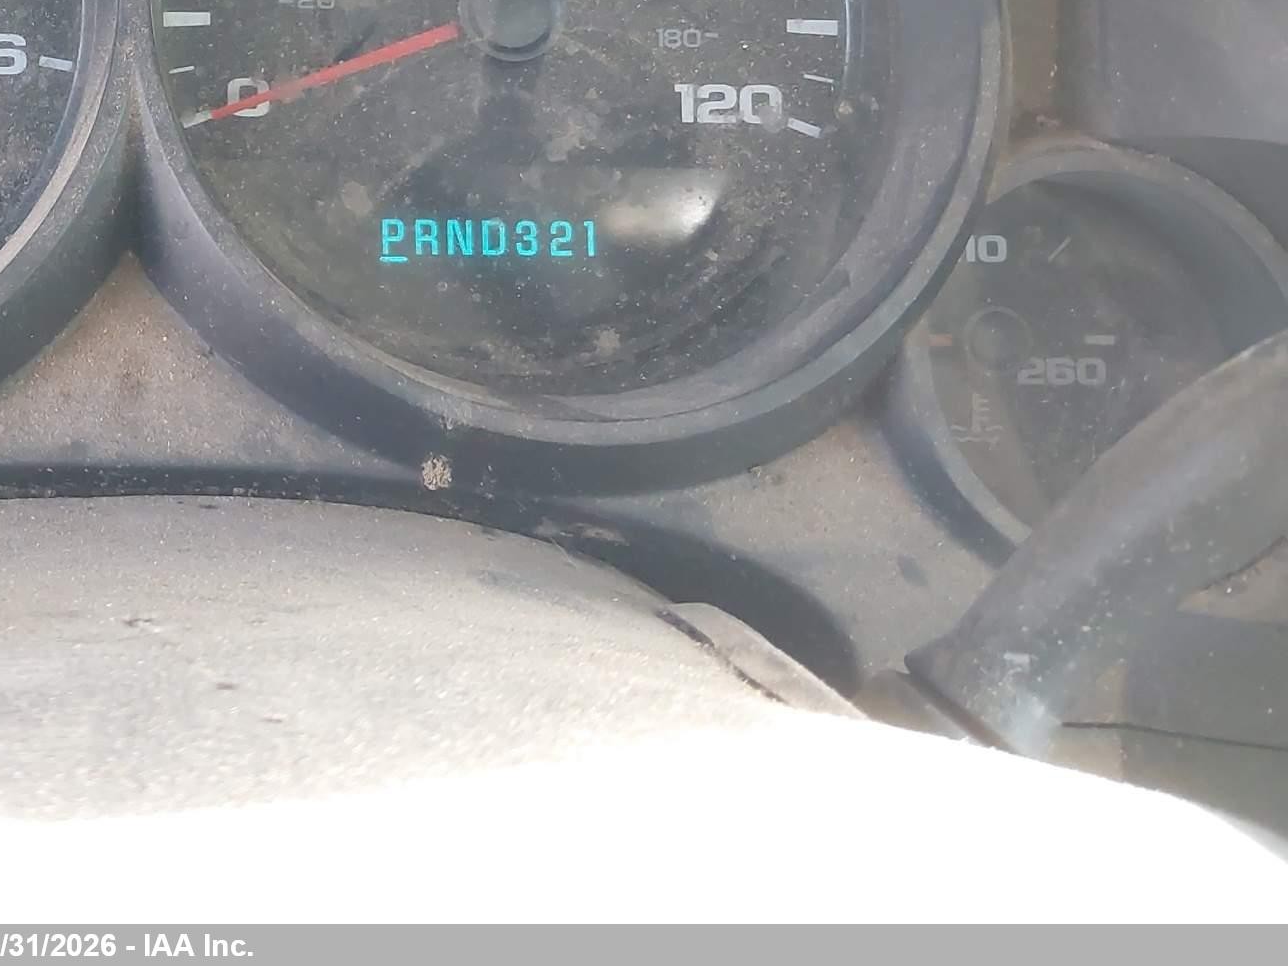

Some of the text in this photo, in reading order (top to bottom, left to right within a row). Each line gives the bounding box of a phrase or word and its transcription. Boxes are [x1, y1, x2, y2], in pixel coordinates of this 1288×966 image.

[656, 29, 701, 48] 180
[227, 78, 270, 117] 0
[674, 85, 783, 124] 120
[1017, 357, 1106, 385] 260
